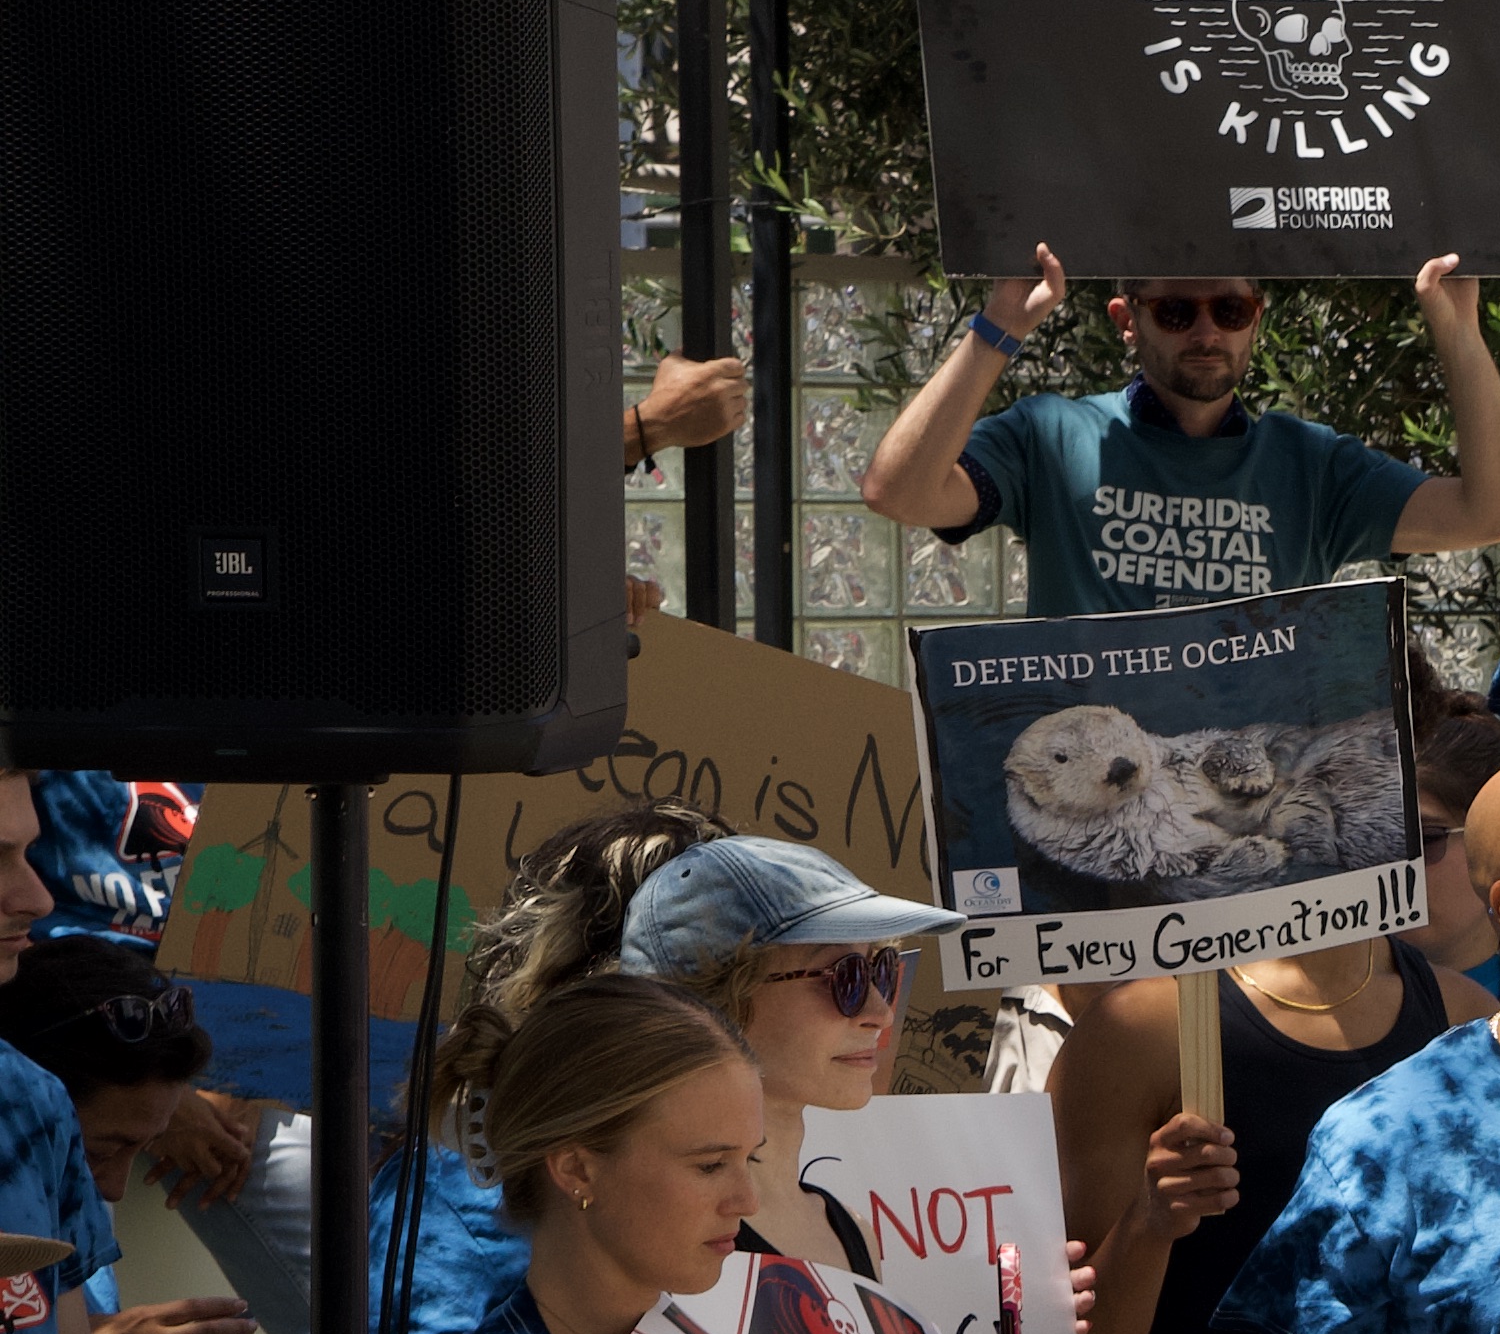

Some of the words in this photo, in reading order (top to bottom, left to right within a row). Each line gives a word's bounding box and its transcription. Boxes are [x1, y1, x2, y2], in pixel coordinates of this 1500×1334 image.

[1143, 36, 1202, 95] IS
[1219, 41, 1450, 160] KILLING
[1277, 186, 1390, 213] SURFRIDER
[1279, 213, 1393, 230] FOUNDATION
[1092, 485, 1274, 534] SURFRIDER
[214, 551, 253, 575] JBL
[1101, 519, 1267, 563] COASTAL
[1092, 549, 1272, 595] DEFENDER
[952, 652, 1095, 688] DEFEND
[1102, 645, 1173, 677] THE
[1182, 626, 1298, 668] OCEAN
[755, 755, 819, 841] is
[961, 927, 1009, 981] For
[1036, 922, 1136, 976] Every
[867, 1185, 1013, 1266] NOT
